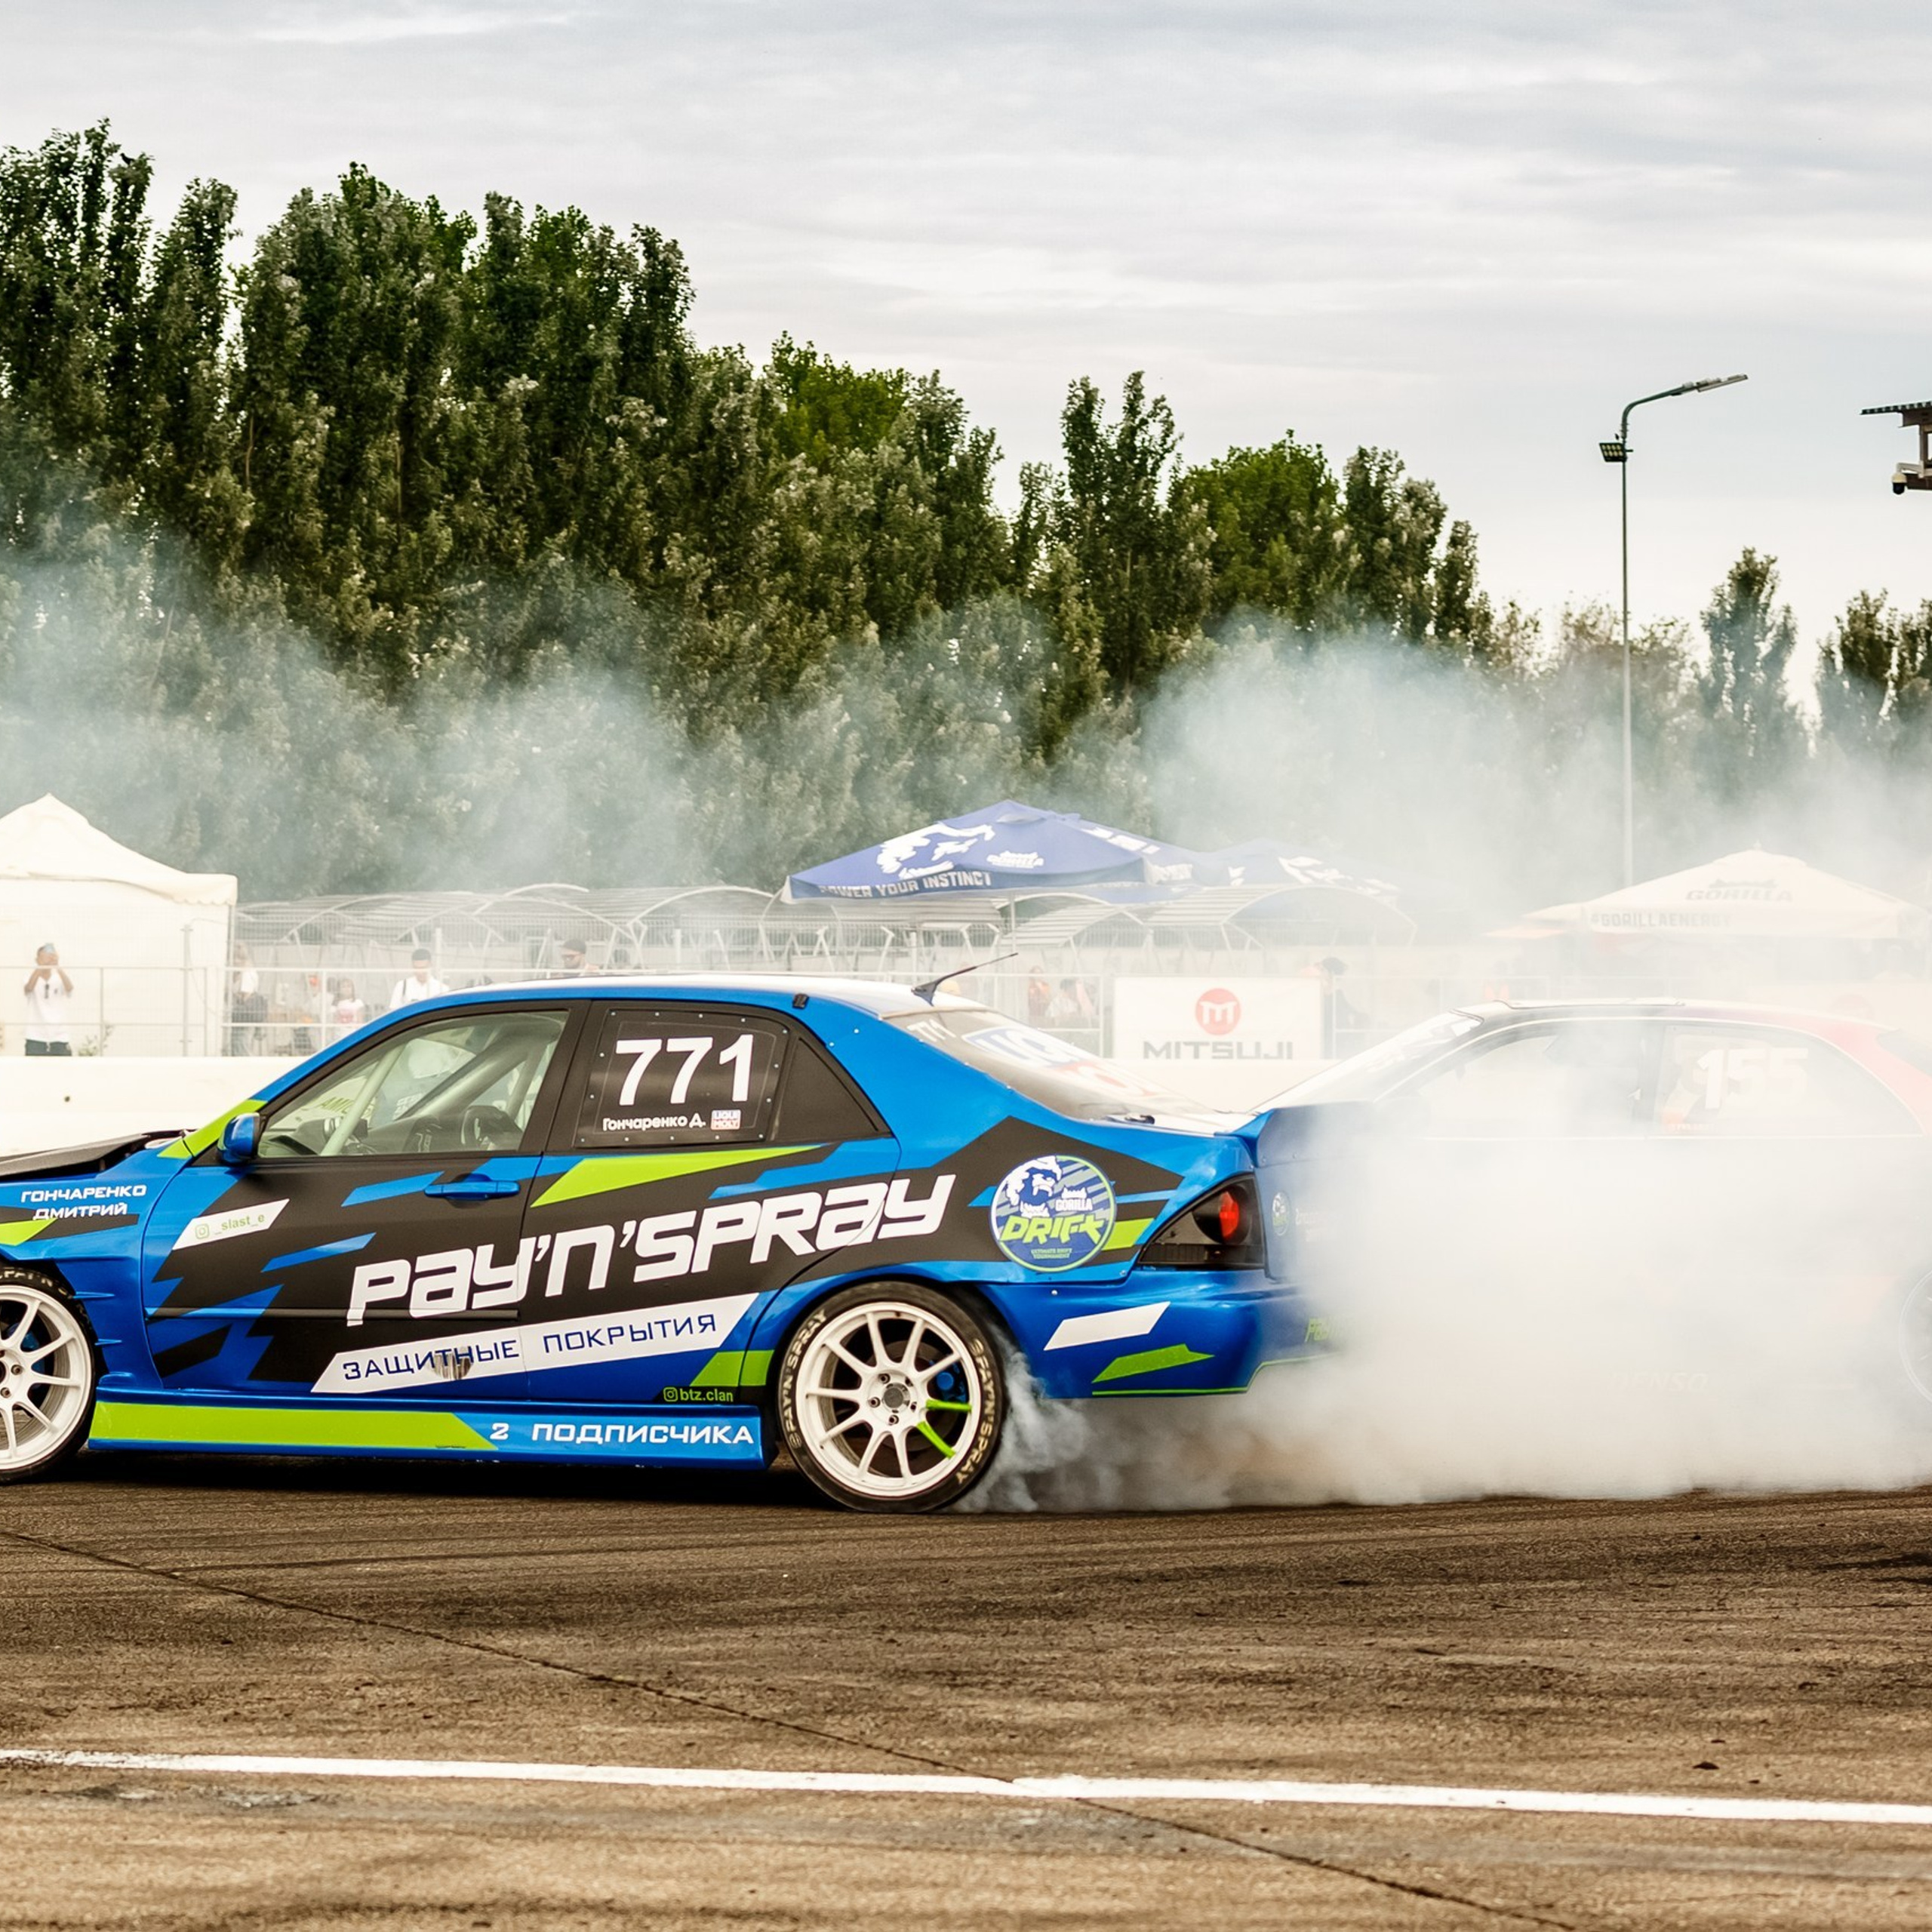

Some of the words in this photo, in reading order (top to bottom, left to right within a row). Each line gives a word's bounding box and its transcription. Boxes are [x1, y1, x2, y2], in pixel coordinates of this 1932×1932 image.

[875, 880, 918, 897] YOUR
[922, 871, 992, 889] INSTINCT
[1685, 888, 1792, 902] GORILLA
[1143, 1041, 1293, 1060] MITSUJI
[615, 1034, 754, 1106] 771
[1697, 1048, 1808, 1109] 155
[603, 1115, 688, 1131] Гончаренко
[20, 1185, 147, 1203] ГОНЧАРЕНКО
[32, 1202, 128, 1220] ДМИТРИЙ
[1055, 1198, 1093, 1211] GORILLA
[999, 1214, 1105, 1244] DRIFT
[343, 1340, 519, 1380] ЗАЩИТНЫЕ
[543, 1314, 717, 1354] ПОКРЫТИЯ
[679, 1388, 734, 1402] btz.clan
[489, 1423, 509, 1440] 2
[531, 1423, 754, 1444] ПОДПИСЧИКА
